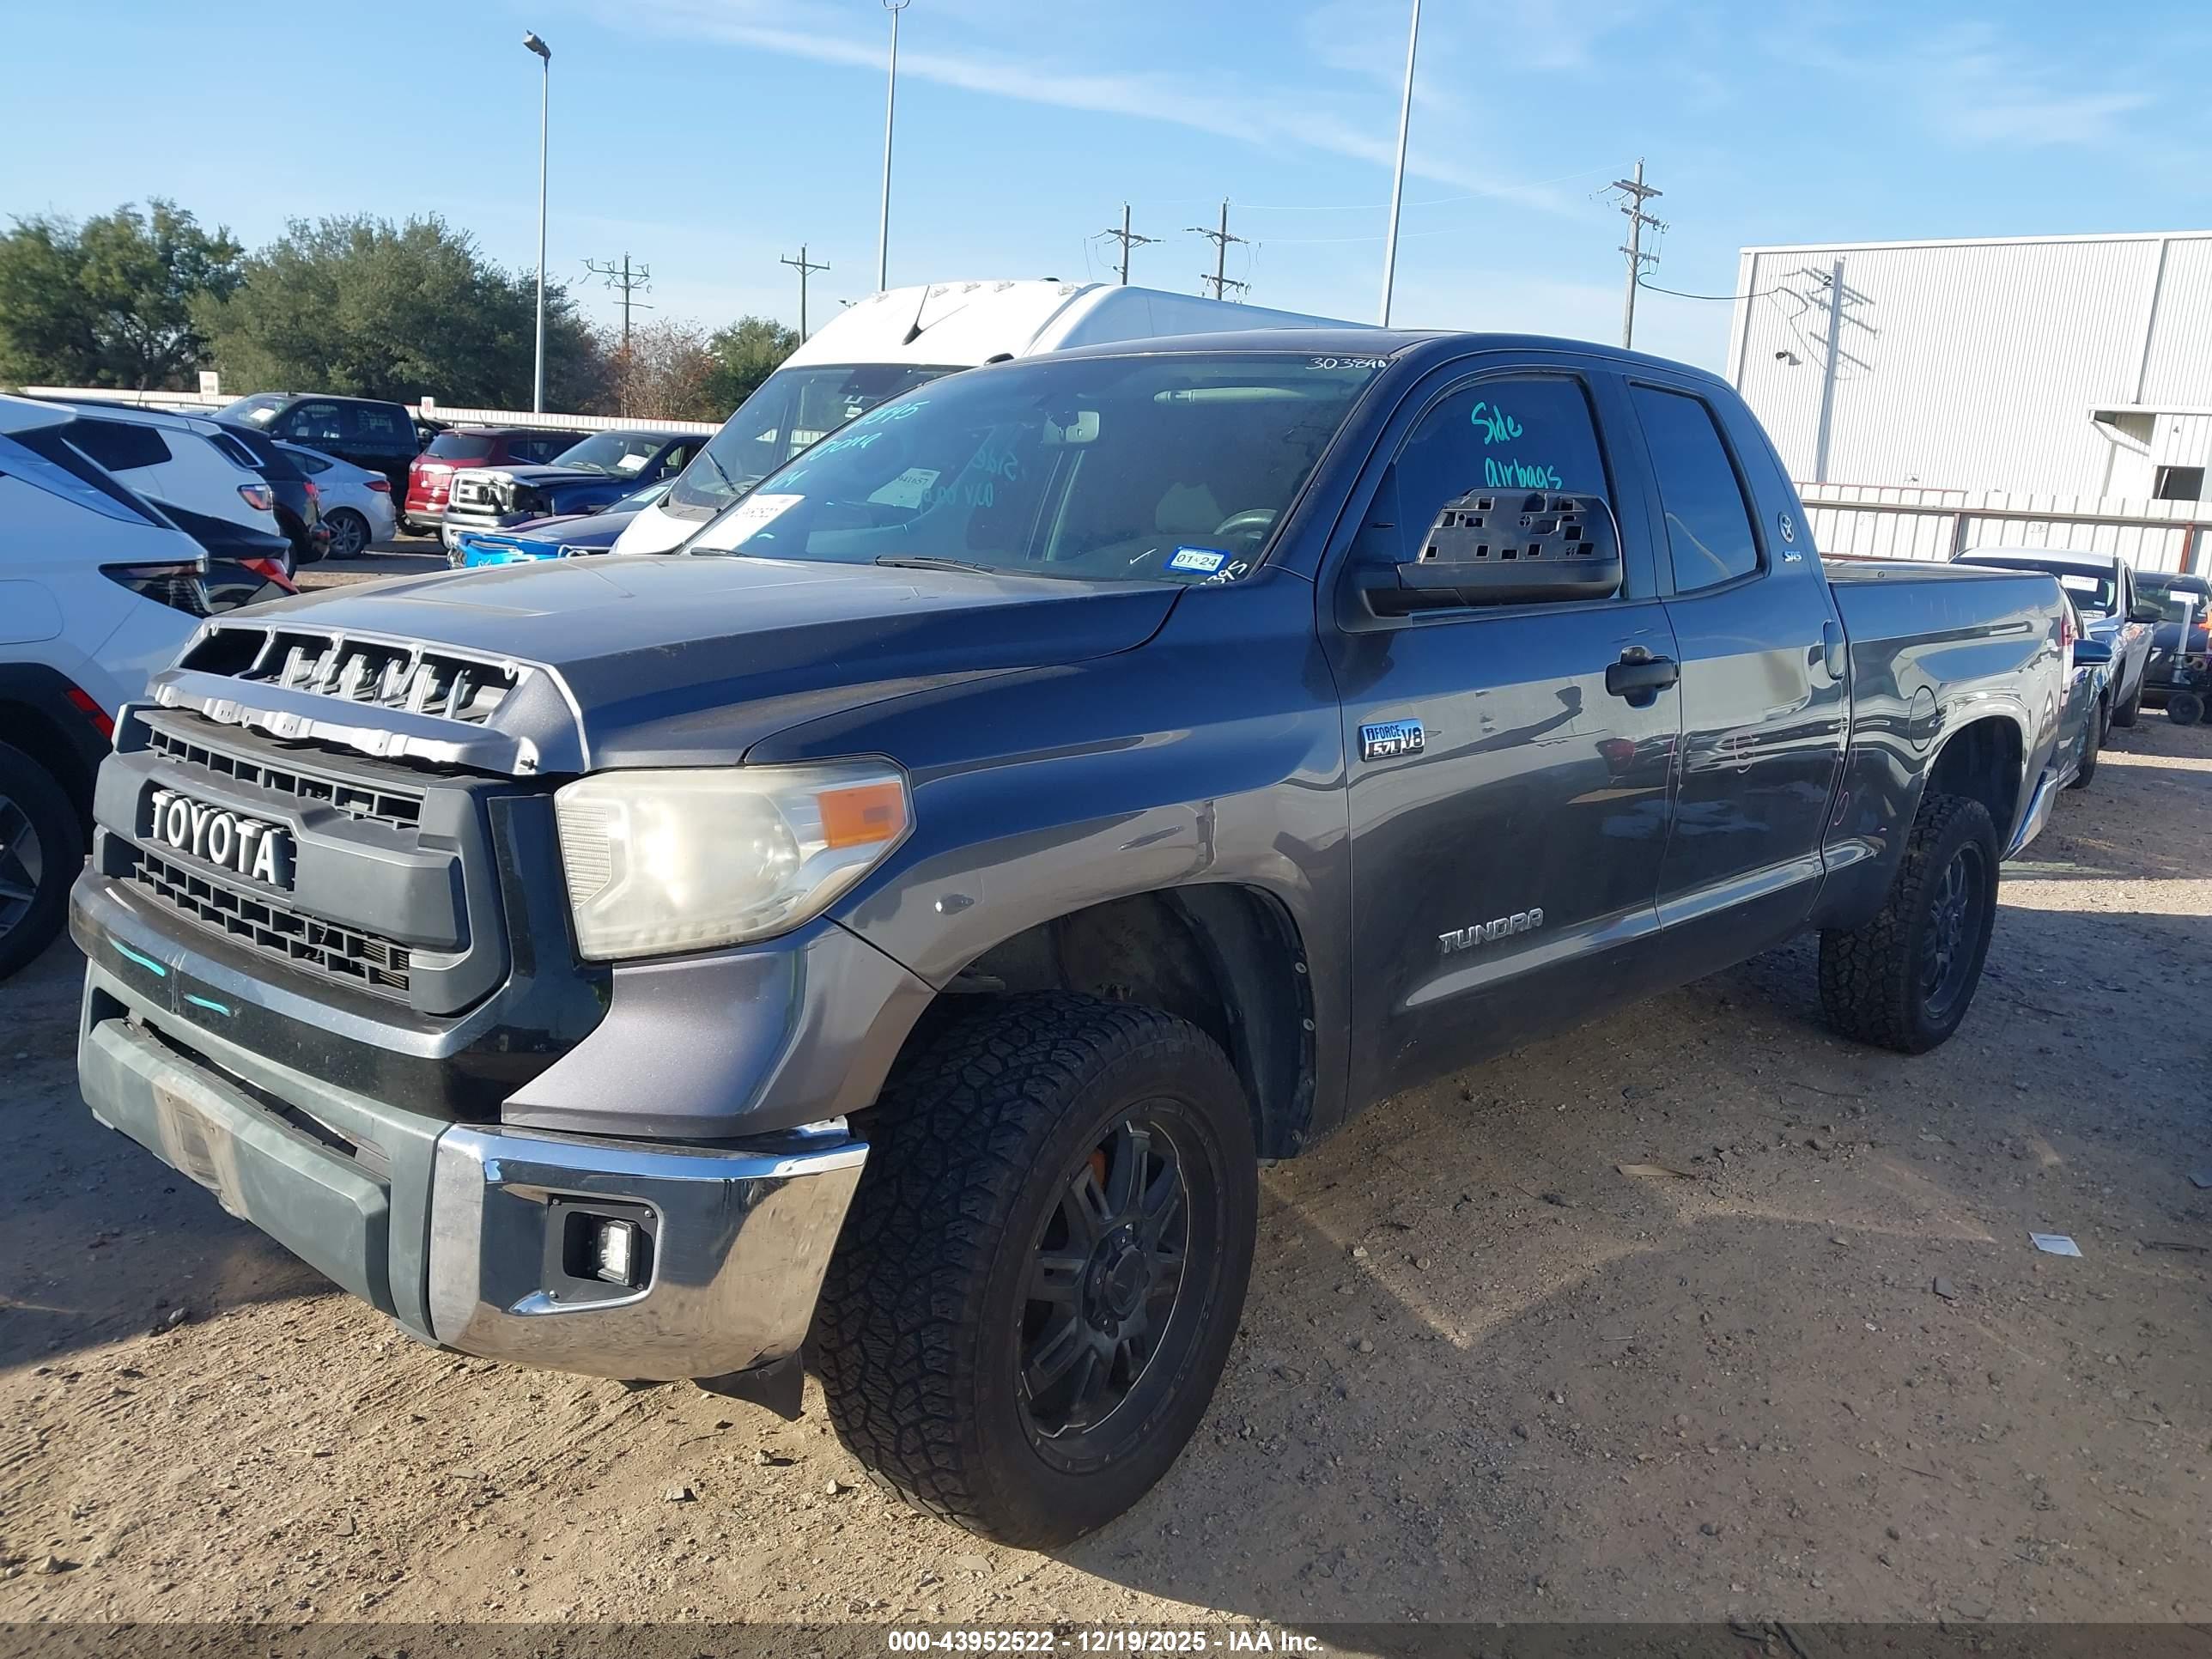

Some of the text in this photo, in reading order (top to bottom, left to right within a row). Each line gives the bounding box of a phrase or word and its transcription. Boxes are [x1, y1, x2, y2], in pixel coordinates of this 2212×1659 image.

[1823, 275, 1832, 286] 2
[152, 790, 284, 884] TOYOTA
[1438, 908, 1543, 953] TUNDRA
